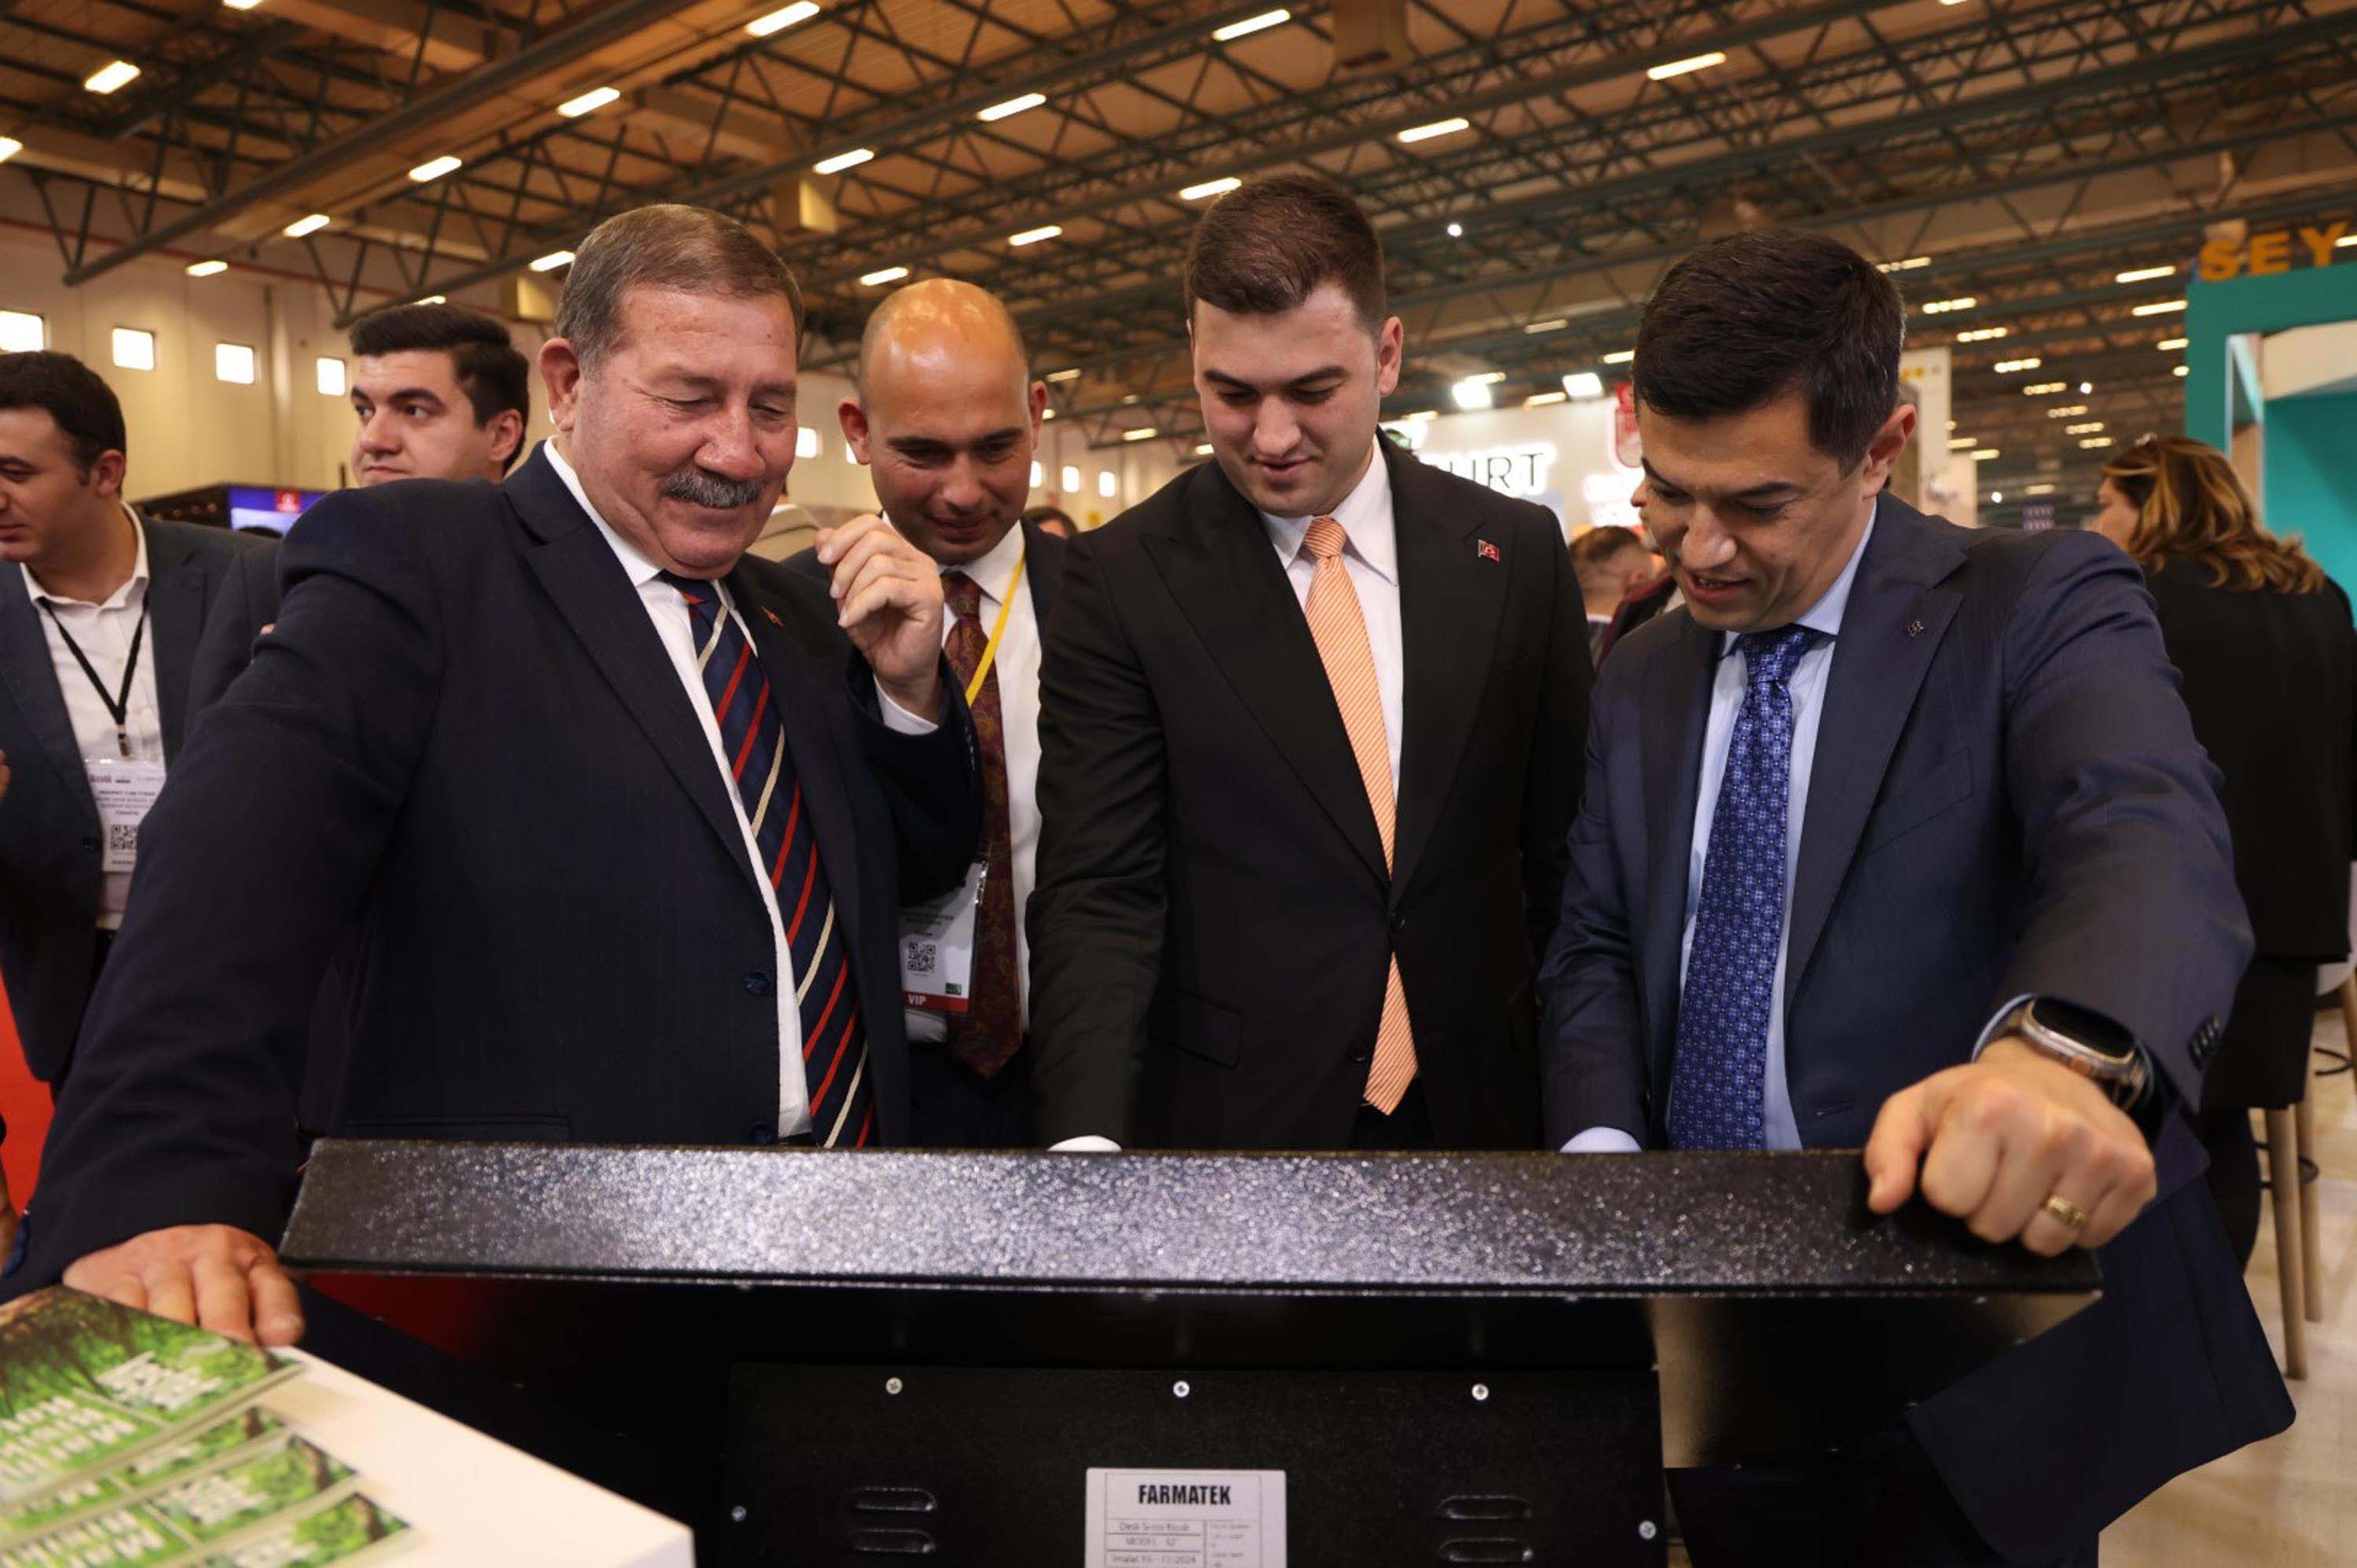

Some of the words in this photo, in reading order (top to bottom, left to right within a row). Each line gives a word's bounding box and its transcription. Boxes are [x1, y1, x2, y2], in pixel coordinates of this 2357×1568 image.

[2199, 222, 2348, 283] SEY
[907, 994, 927, 1006] VIP
[1138, 1485, 1231, 1505] FARMATEK
